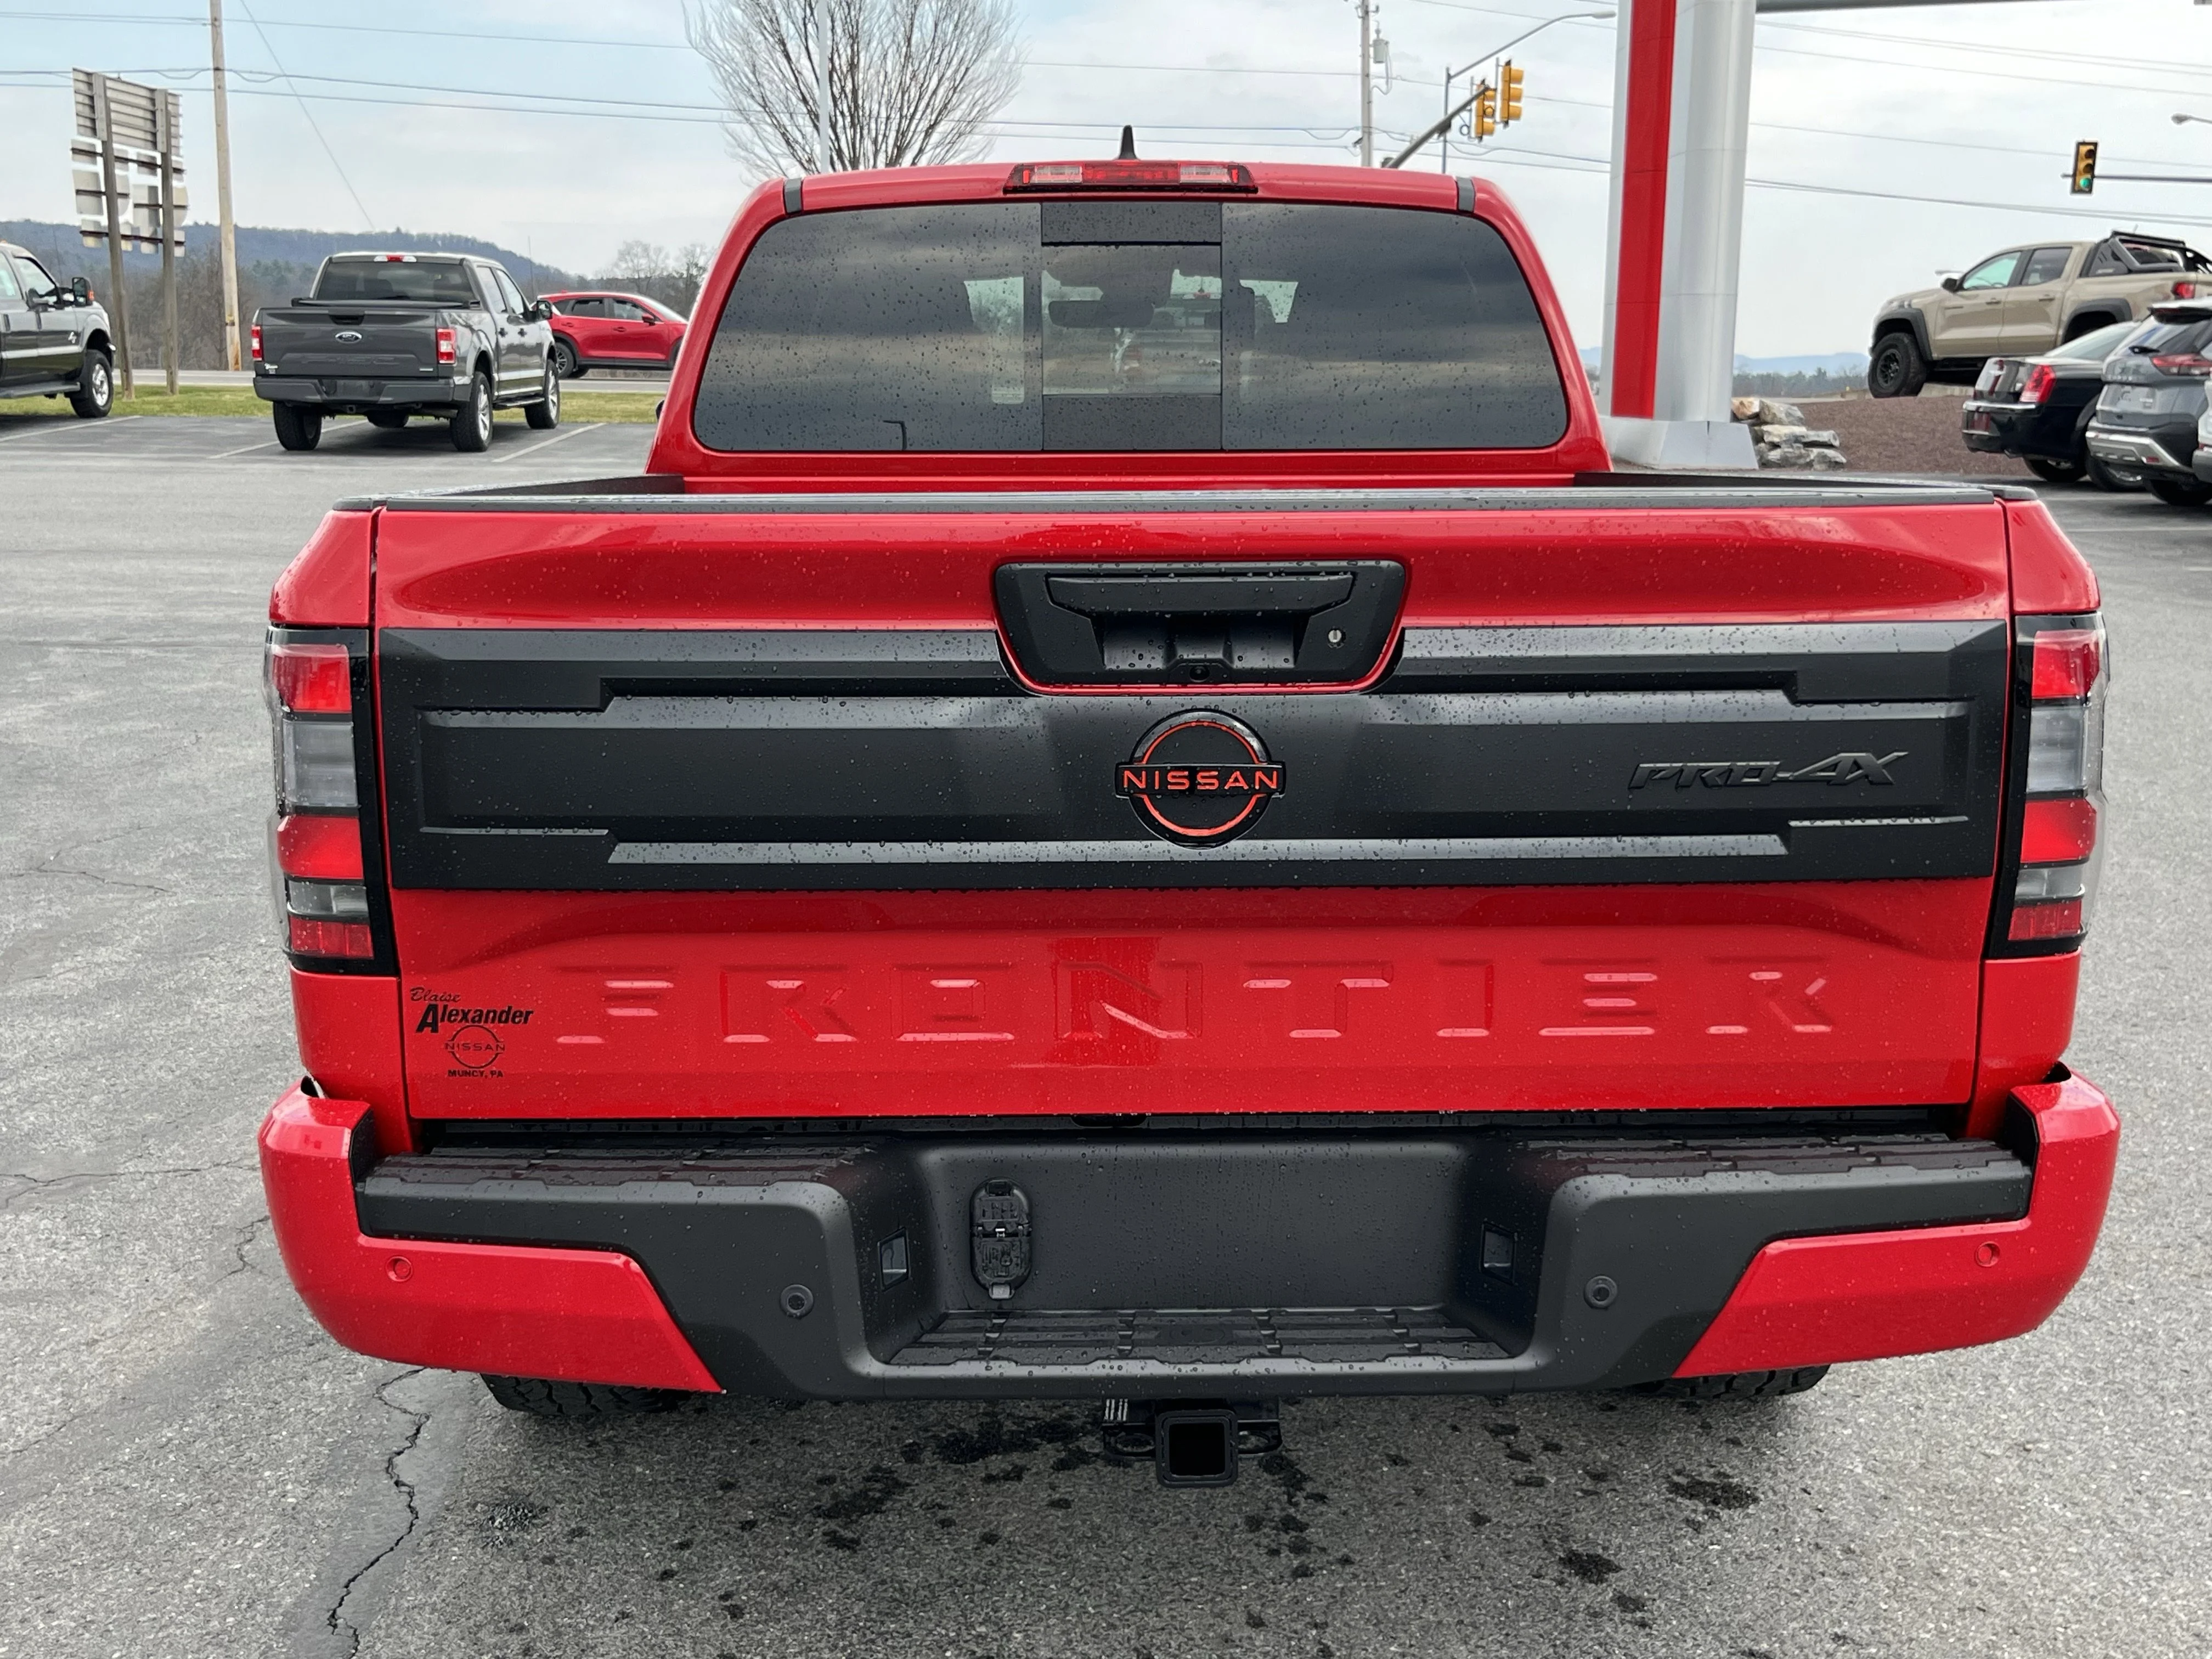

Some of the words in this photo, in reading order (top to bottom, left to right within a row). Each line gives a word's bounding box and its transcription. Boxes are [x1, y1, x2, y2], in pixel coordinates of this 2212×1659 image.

[1123, 770, 1278, 789] NISSAN
[1628, 752, 1909, 789] PRO-4X
[410, 987, 461, 1002] Blaise
[553, 957, 1834, 1045] FRONTIER
[415, 1003, 534, 1033] Alexander
[445, 1043, 505, 1051] NISSAN
[448, 1070, 488, 1079] MUNCY,
